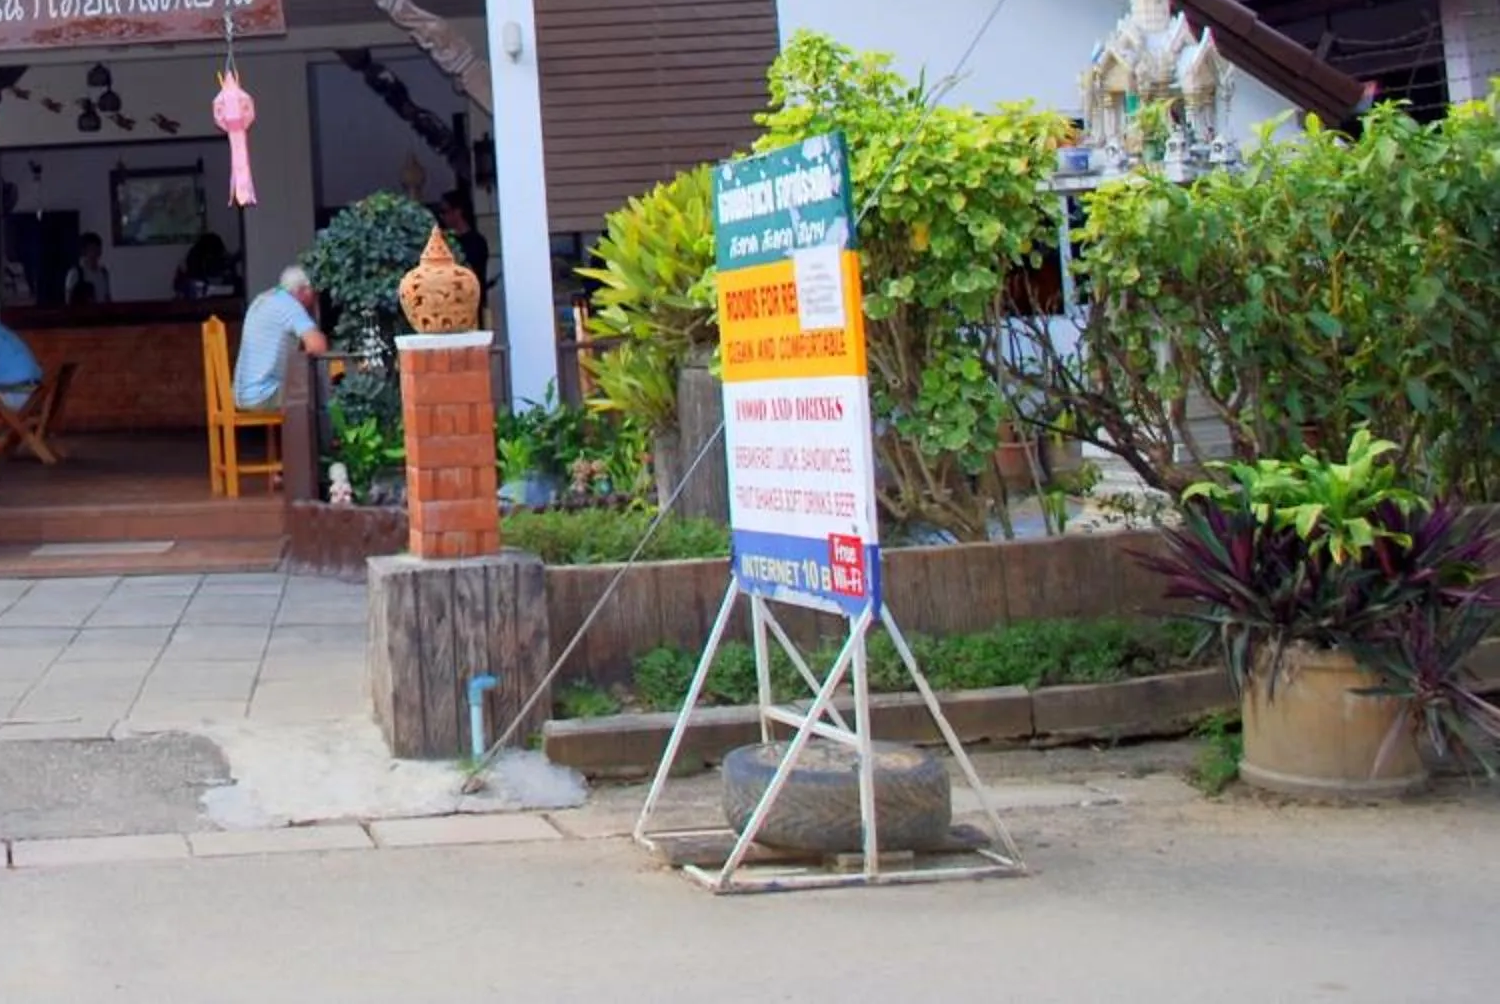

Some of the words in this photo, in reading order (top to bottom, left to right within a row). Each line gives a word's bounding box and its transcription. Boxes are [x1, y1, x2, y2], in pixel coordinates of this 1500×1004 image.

[726, 287, 758, 321] ROOMS
[760, 283, 780, 316] FOR
[758, 337, 776, 360] AND
[779, 329, 848, 360] COMFORTABLE
[736, 398, 767, 421] FOOD
[770, 397, 793, 421] AND
[796, 396, 844, 421] DRINKS
[833, 537, 858, 563] Free
[741, 553, 801, 586] INTERNET
[803, 557, 820, 590] 10
[832, 563, 863, 593] Wi-Fi
